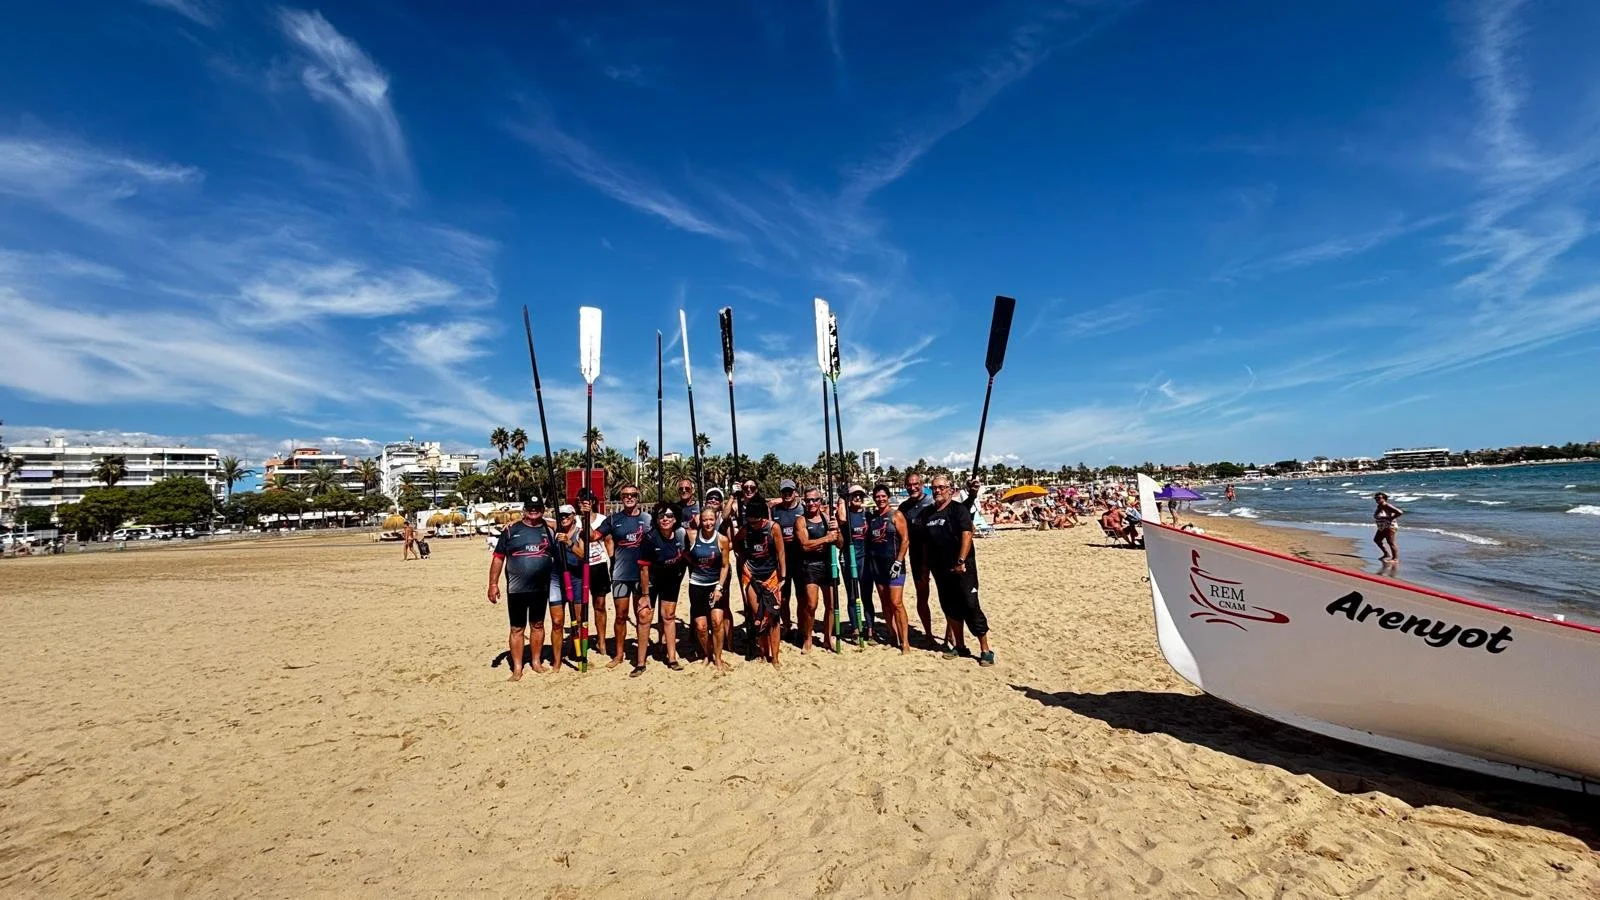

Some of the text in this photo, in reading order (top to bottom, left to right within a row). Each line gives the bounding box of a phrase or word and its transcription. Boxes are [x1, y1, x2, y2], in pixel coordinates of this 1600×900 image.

[1210, 584, 1244, 601] REM
[1218, 600, 1246, 611] CNAM
[1326, 591, 1513, 654] Arenyot
